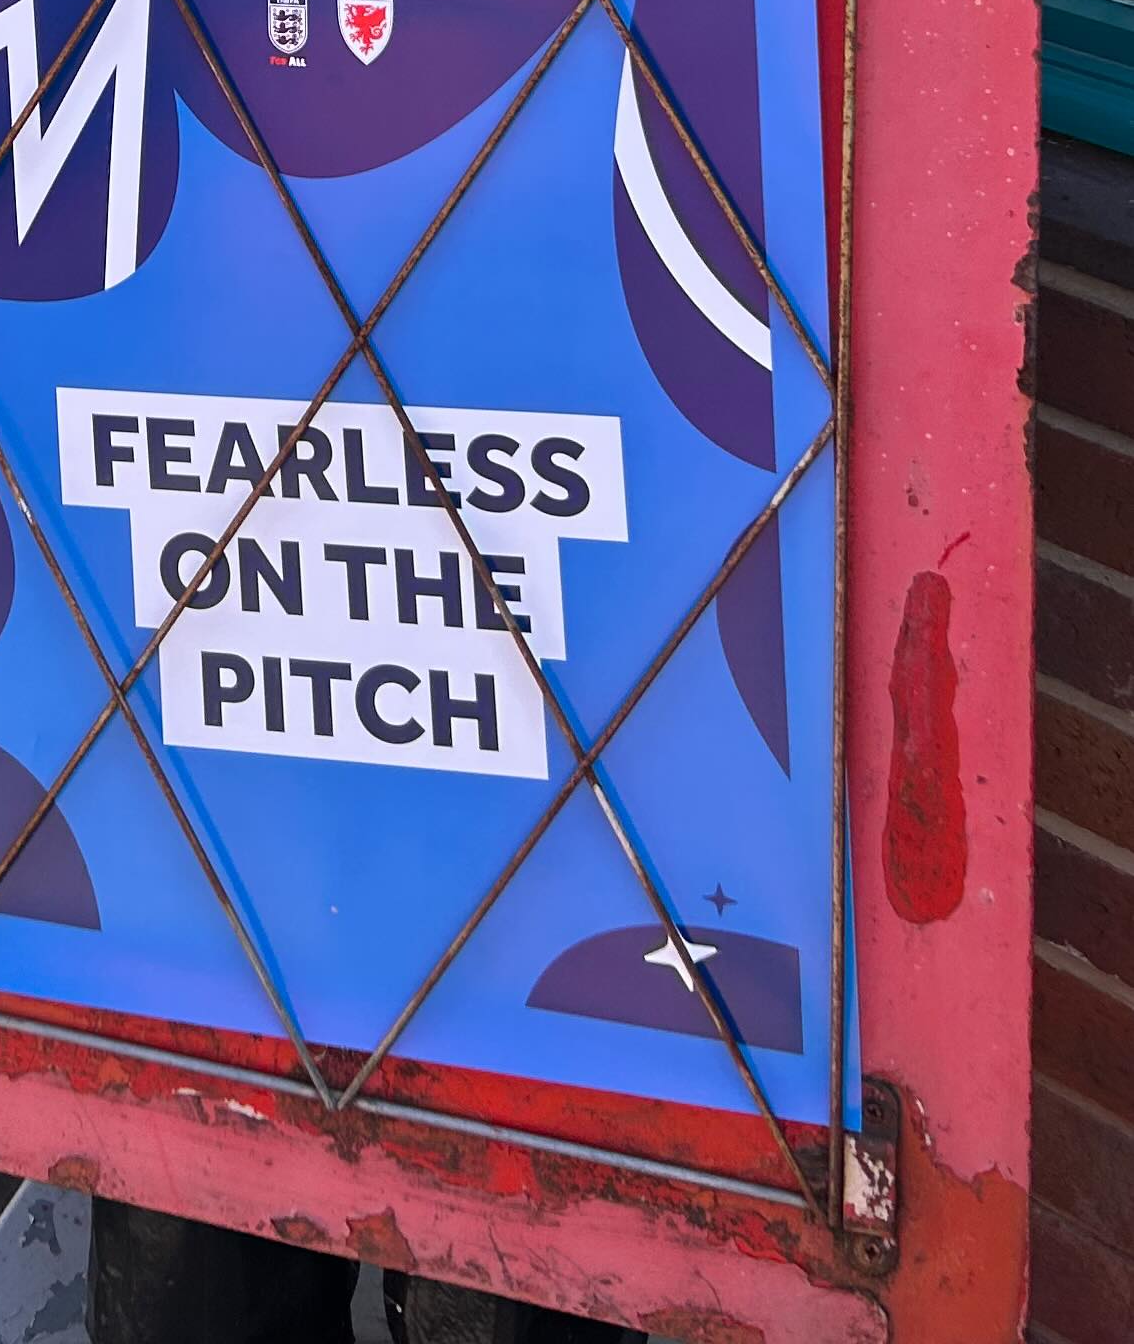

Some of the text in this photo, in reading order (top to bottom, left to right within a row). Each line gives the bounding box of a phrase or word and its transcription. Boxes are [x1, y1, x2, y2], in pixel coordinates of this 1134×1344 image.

[91, 412, 591, 518] FEARLESS
[159, 531, 533, 634] ON THE
[200, 650, 500, 753] PITCH
